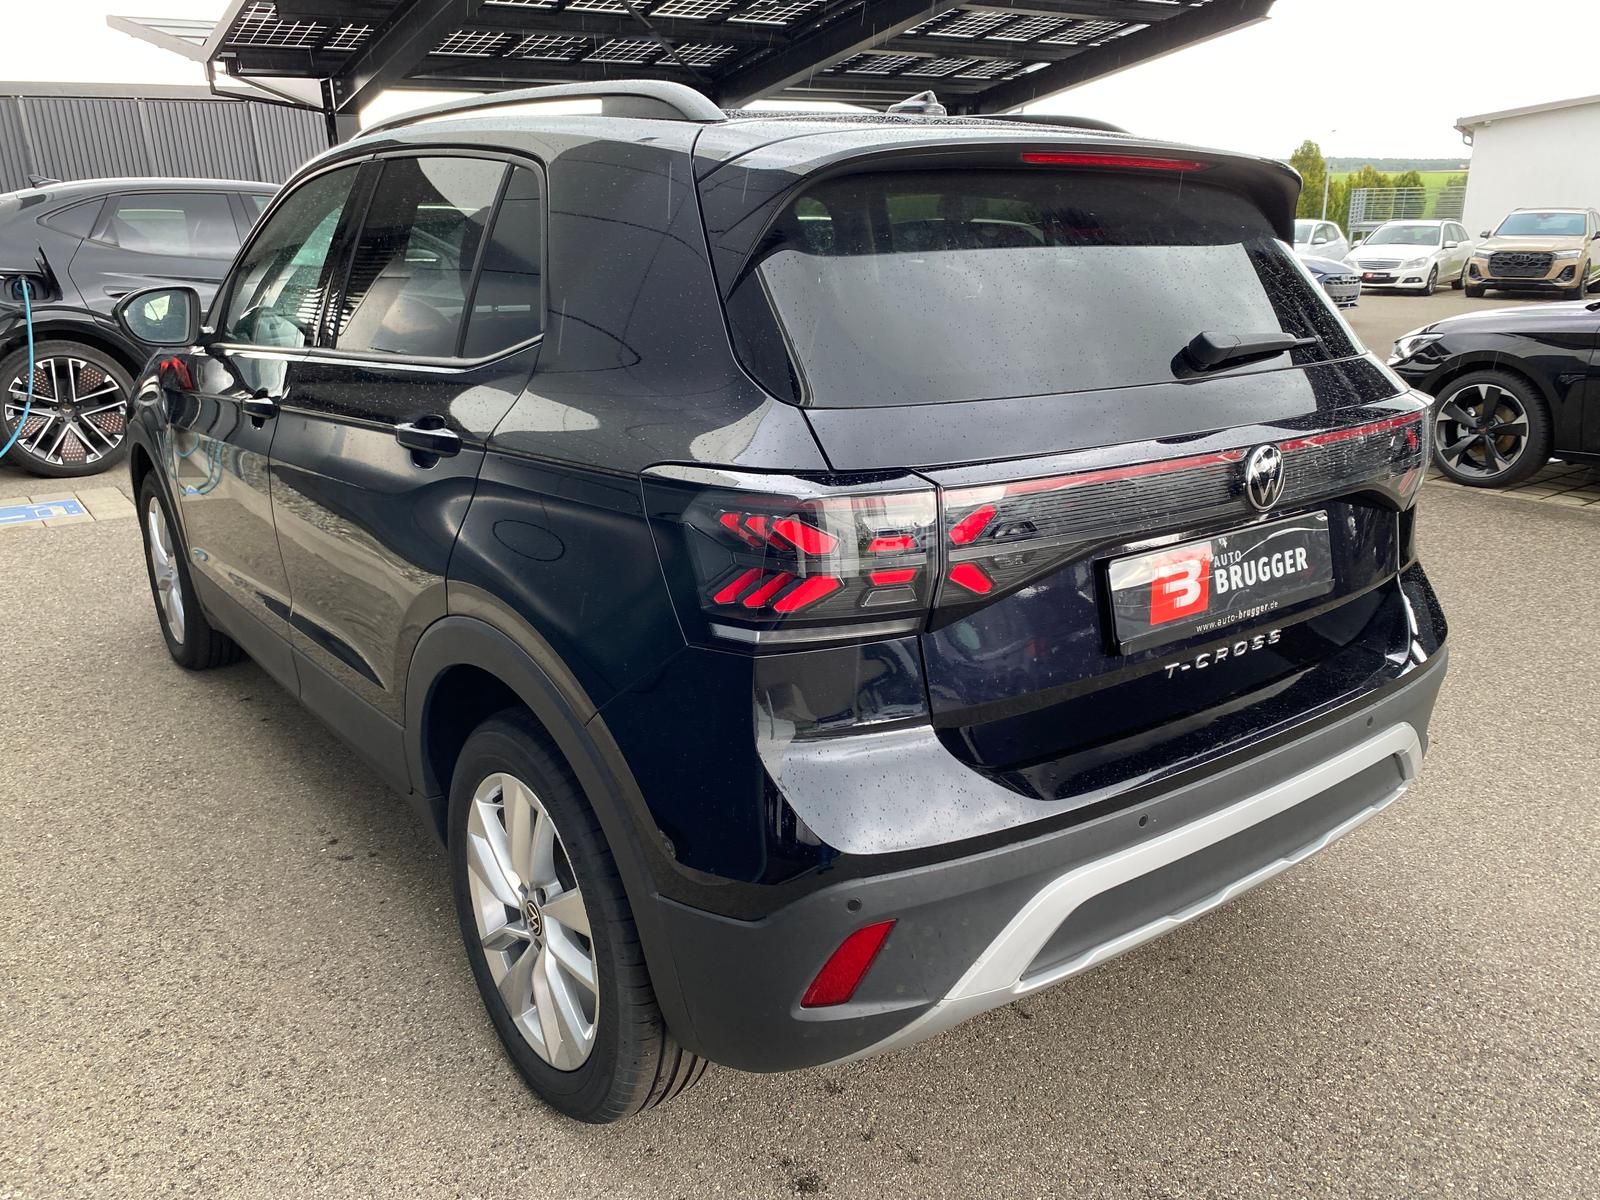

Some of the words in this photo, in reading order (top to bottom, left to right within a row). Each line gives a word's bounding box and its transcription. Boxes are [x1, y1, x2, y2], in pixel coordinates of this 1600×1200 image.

[1213, 550, 1242, 568] AUTO
[1214, 547, 1309, 595] BRUGGER
[1196, 600, 1279, 633] www.auto-brugger.de
[1164, 628, 1282, 679] T-CROSS
